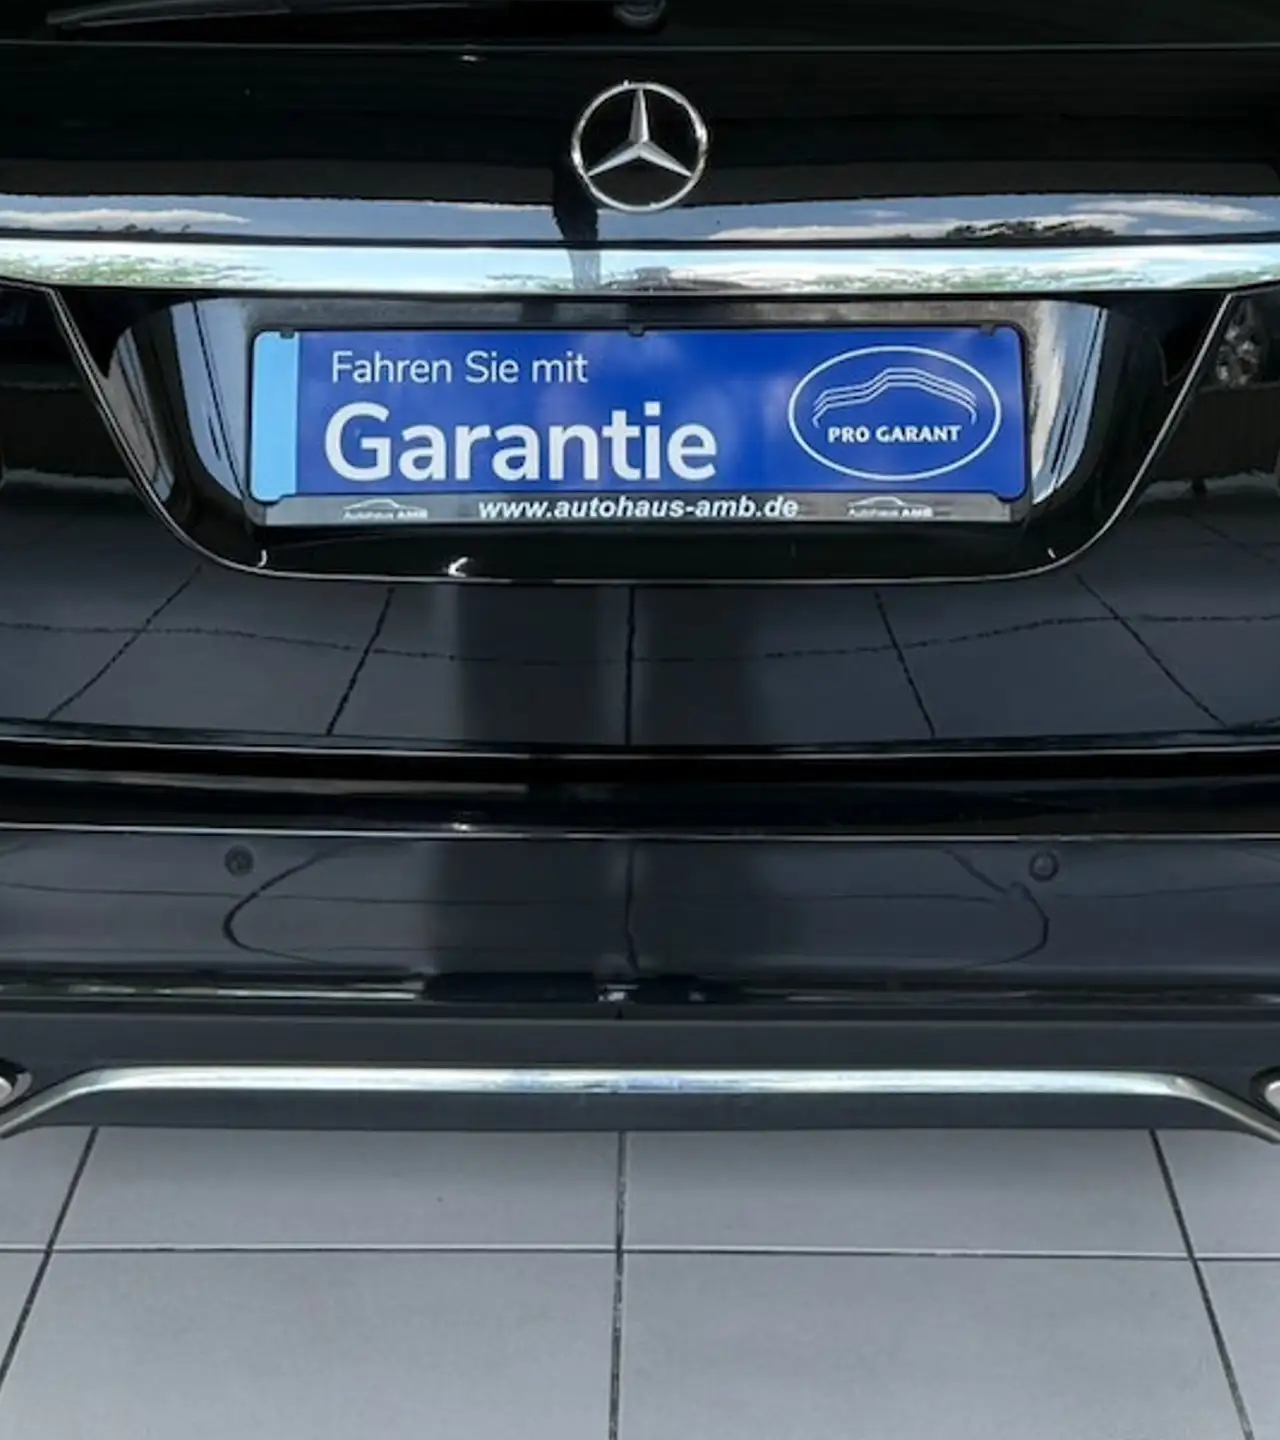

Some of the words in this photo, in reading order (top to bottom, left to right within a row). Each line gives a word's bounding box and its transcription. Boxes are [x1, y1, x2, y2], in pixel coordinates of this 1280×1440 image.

[332, 352, 452, 384] Fahren
[465, 352, 520, 384] Sie
[531, 352, 588, 384] mit
[325, 401, 717, 482] Garantie
[828, 425, 870, 443] PRO
[876, 425, 962, 443] GARANT
[479, 497, 798, 521] www.autohaus-amb.de
